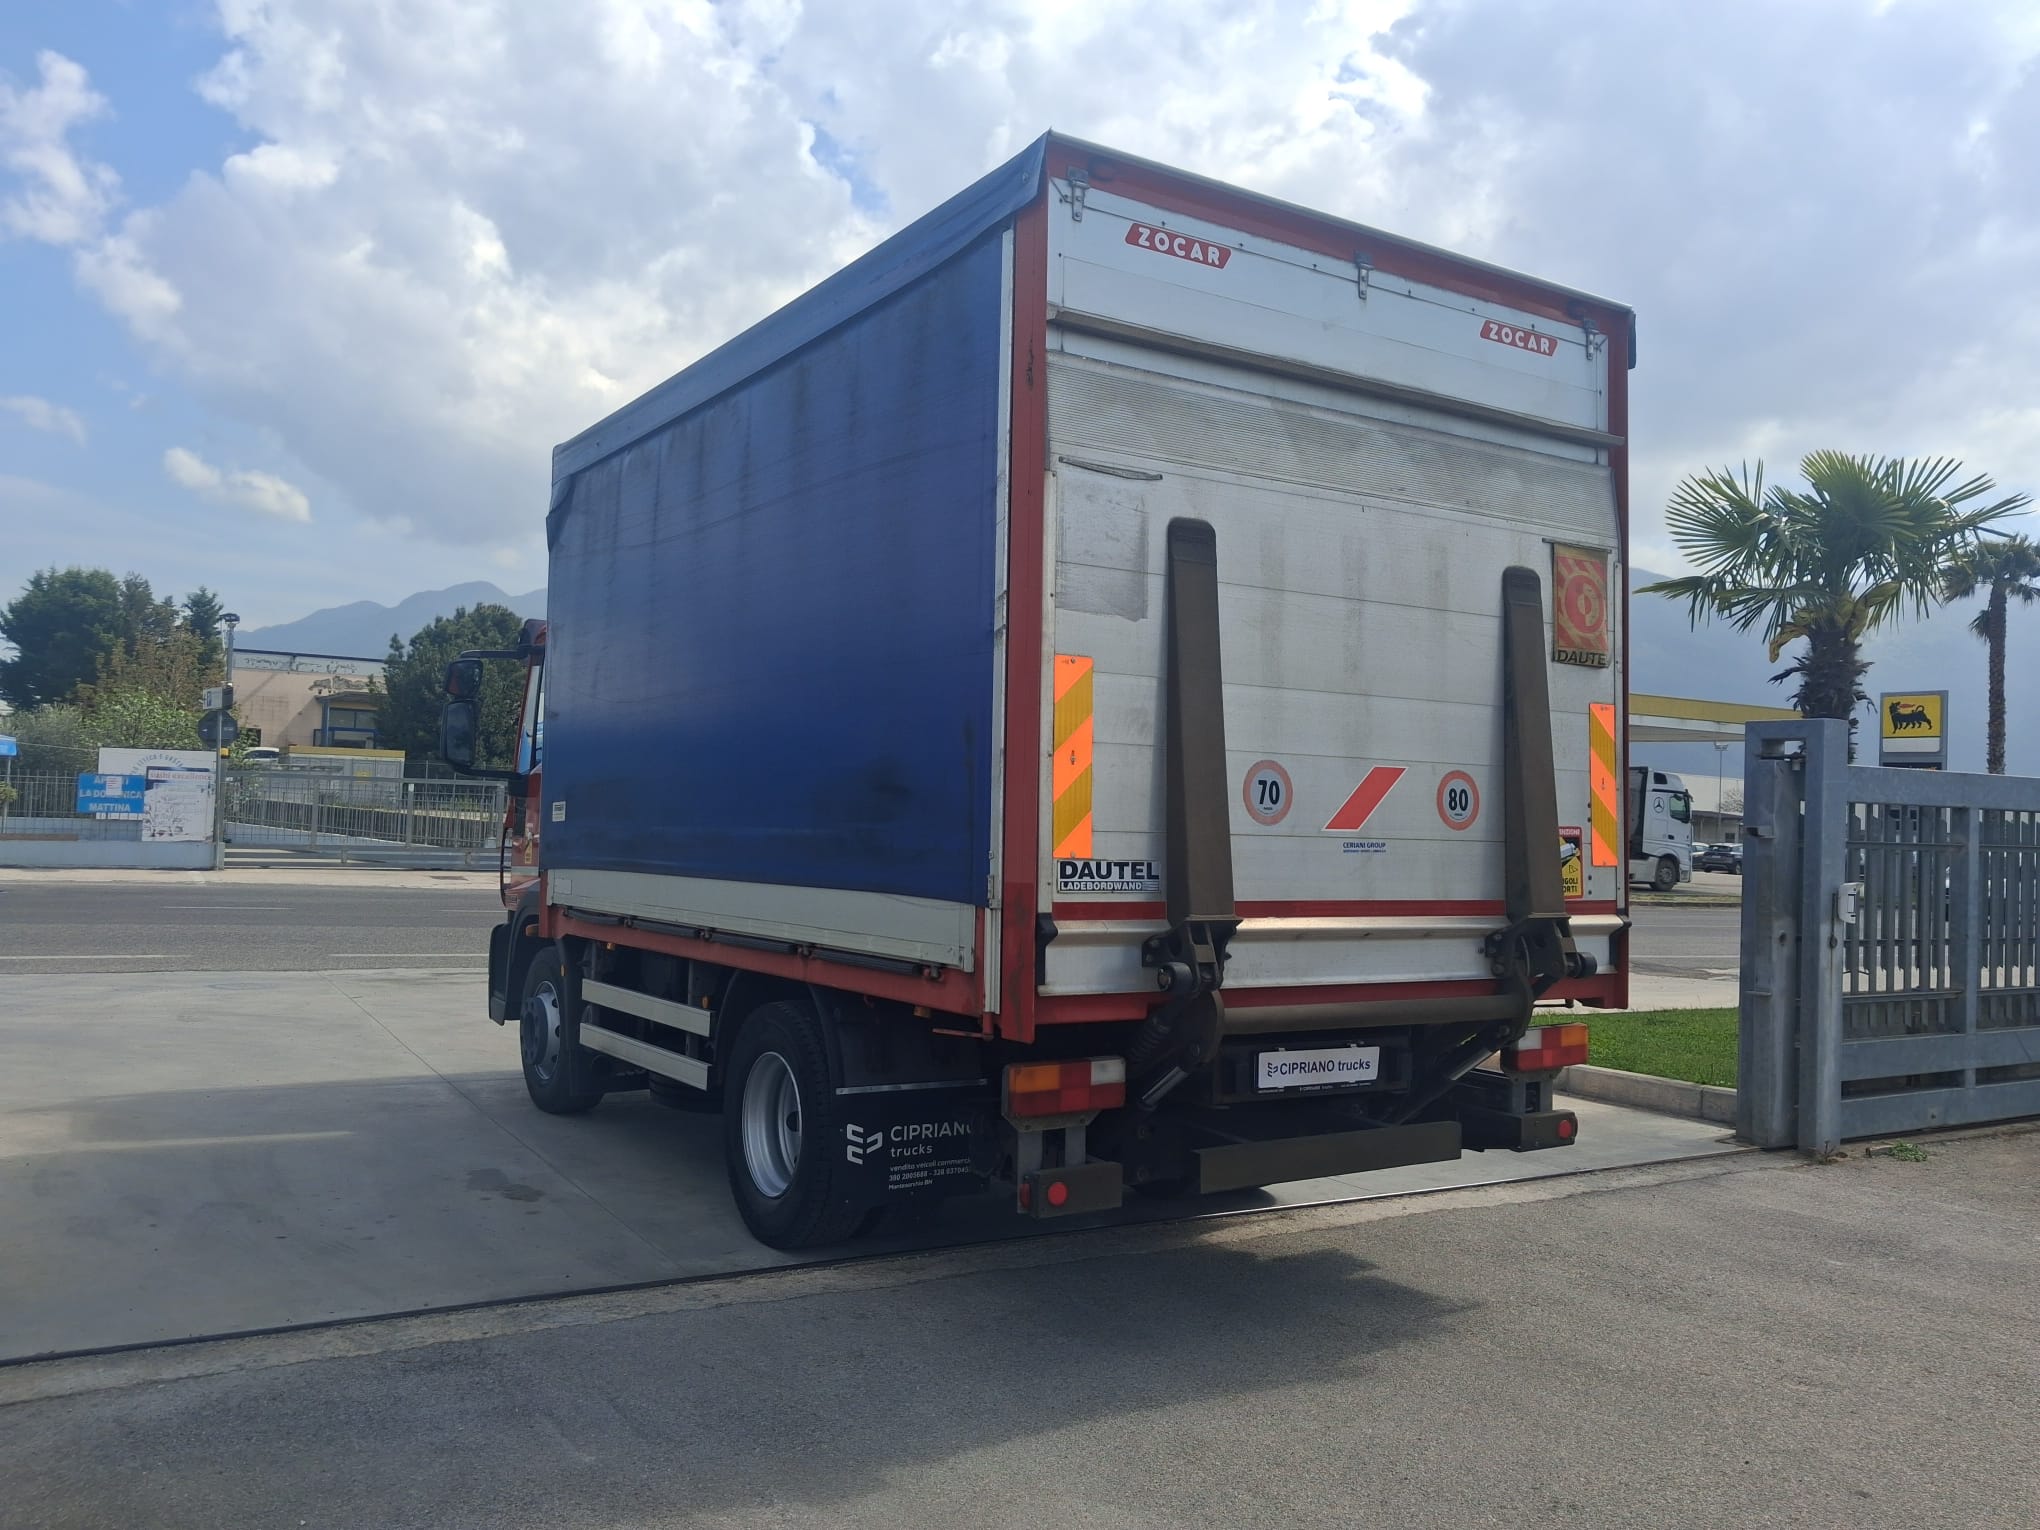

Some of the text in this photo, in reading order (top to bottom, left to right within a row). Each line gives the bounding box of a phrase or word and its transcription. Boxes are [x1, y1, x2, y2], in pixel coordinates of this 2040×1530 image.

[1138, 227, 1220, 266] ZOCAR
[1488, 323, 1550, 354] ZOCAR
[1557, 649, 1607, 666] DAUTE
[94, 775, 130, 785] API
[79, 789, 143, 799] LA DONICA
[1257, 779, 1280, 805] 70
[1448, 788, 1469, 812] 80
[89, 803, 131, 812] MATTINA
[1342, 841, 1386, 849] CERIANI GROUP
[1060, 861, 1160, 880] DAUTEL
[1061, 881, 1143, 891] LADEBORDWAND
[1562, 877, 1579, 885] GOLI
[1561, 885, 1578, 893] ORTI
[1280, 1059, 1371, 1076] CIPRIANO trucks
[890, 1144, 934, 1158] trucks
